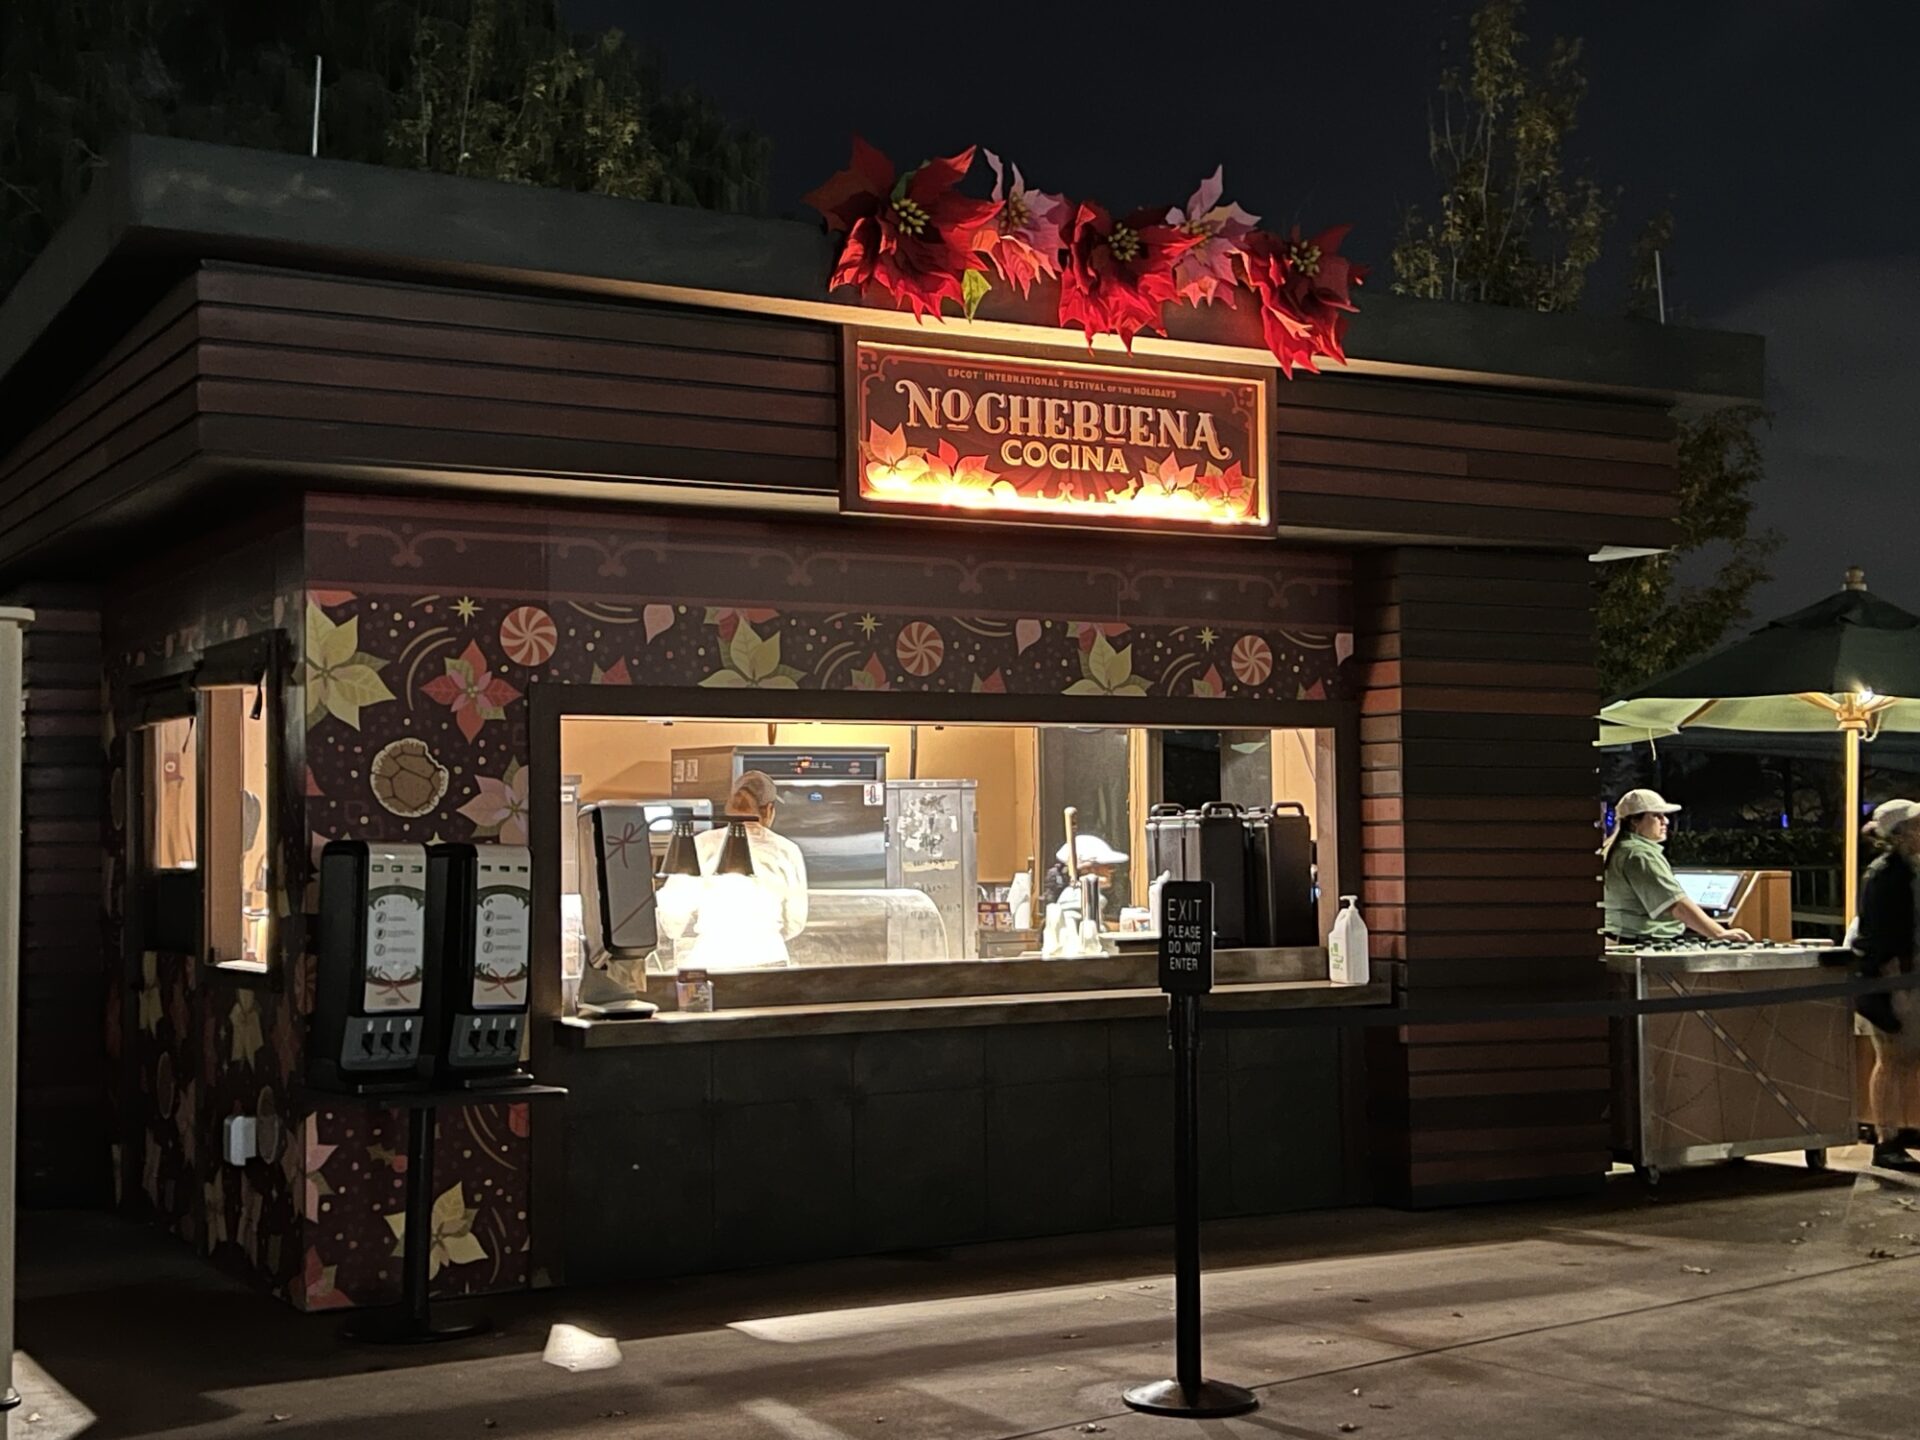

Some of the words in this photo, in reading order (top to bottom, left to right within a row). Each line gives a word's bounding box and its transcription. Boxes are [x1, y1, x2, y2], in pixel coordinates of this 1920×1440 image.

[947, 368, 978, 380] EPCOT
[984, 372, 1060, 387] INTERNATIONAL
[1063, 380, 1106, 392] FESTIVAL
[1107, 385, 1117, 393] OF
[1118, 386, 1132, 394] THE
[1133, 386, 1177, 399] HOLIDAYS
[895, 379, 1232, 460] NOCHEBUENA
[1001, 438, 1129, 473] COCINA
[1167, 898, 1202, 921] EXIT
[1167, 925, 1201, 939] PLEASE
[1168, 940, 1182, 954] DO
[1185, 941, 1202, 955] NOT
[1169, 956, 1199, 971] ENTER
